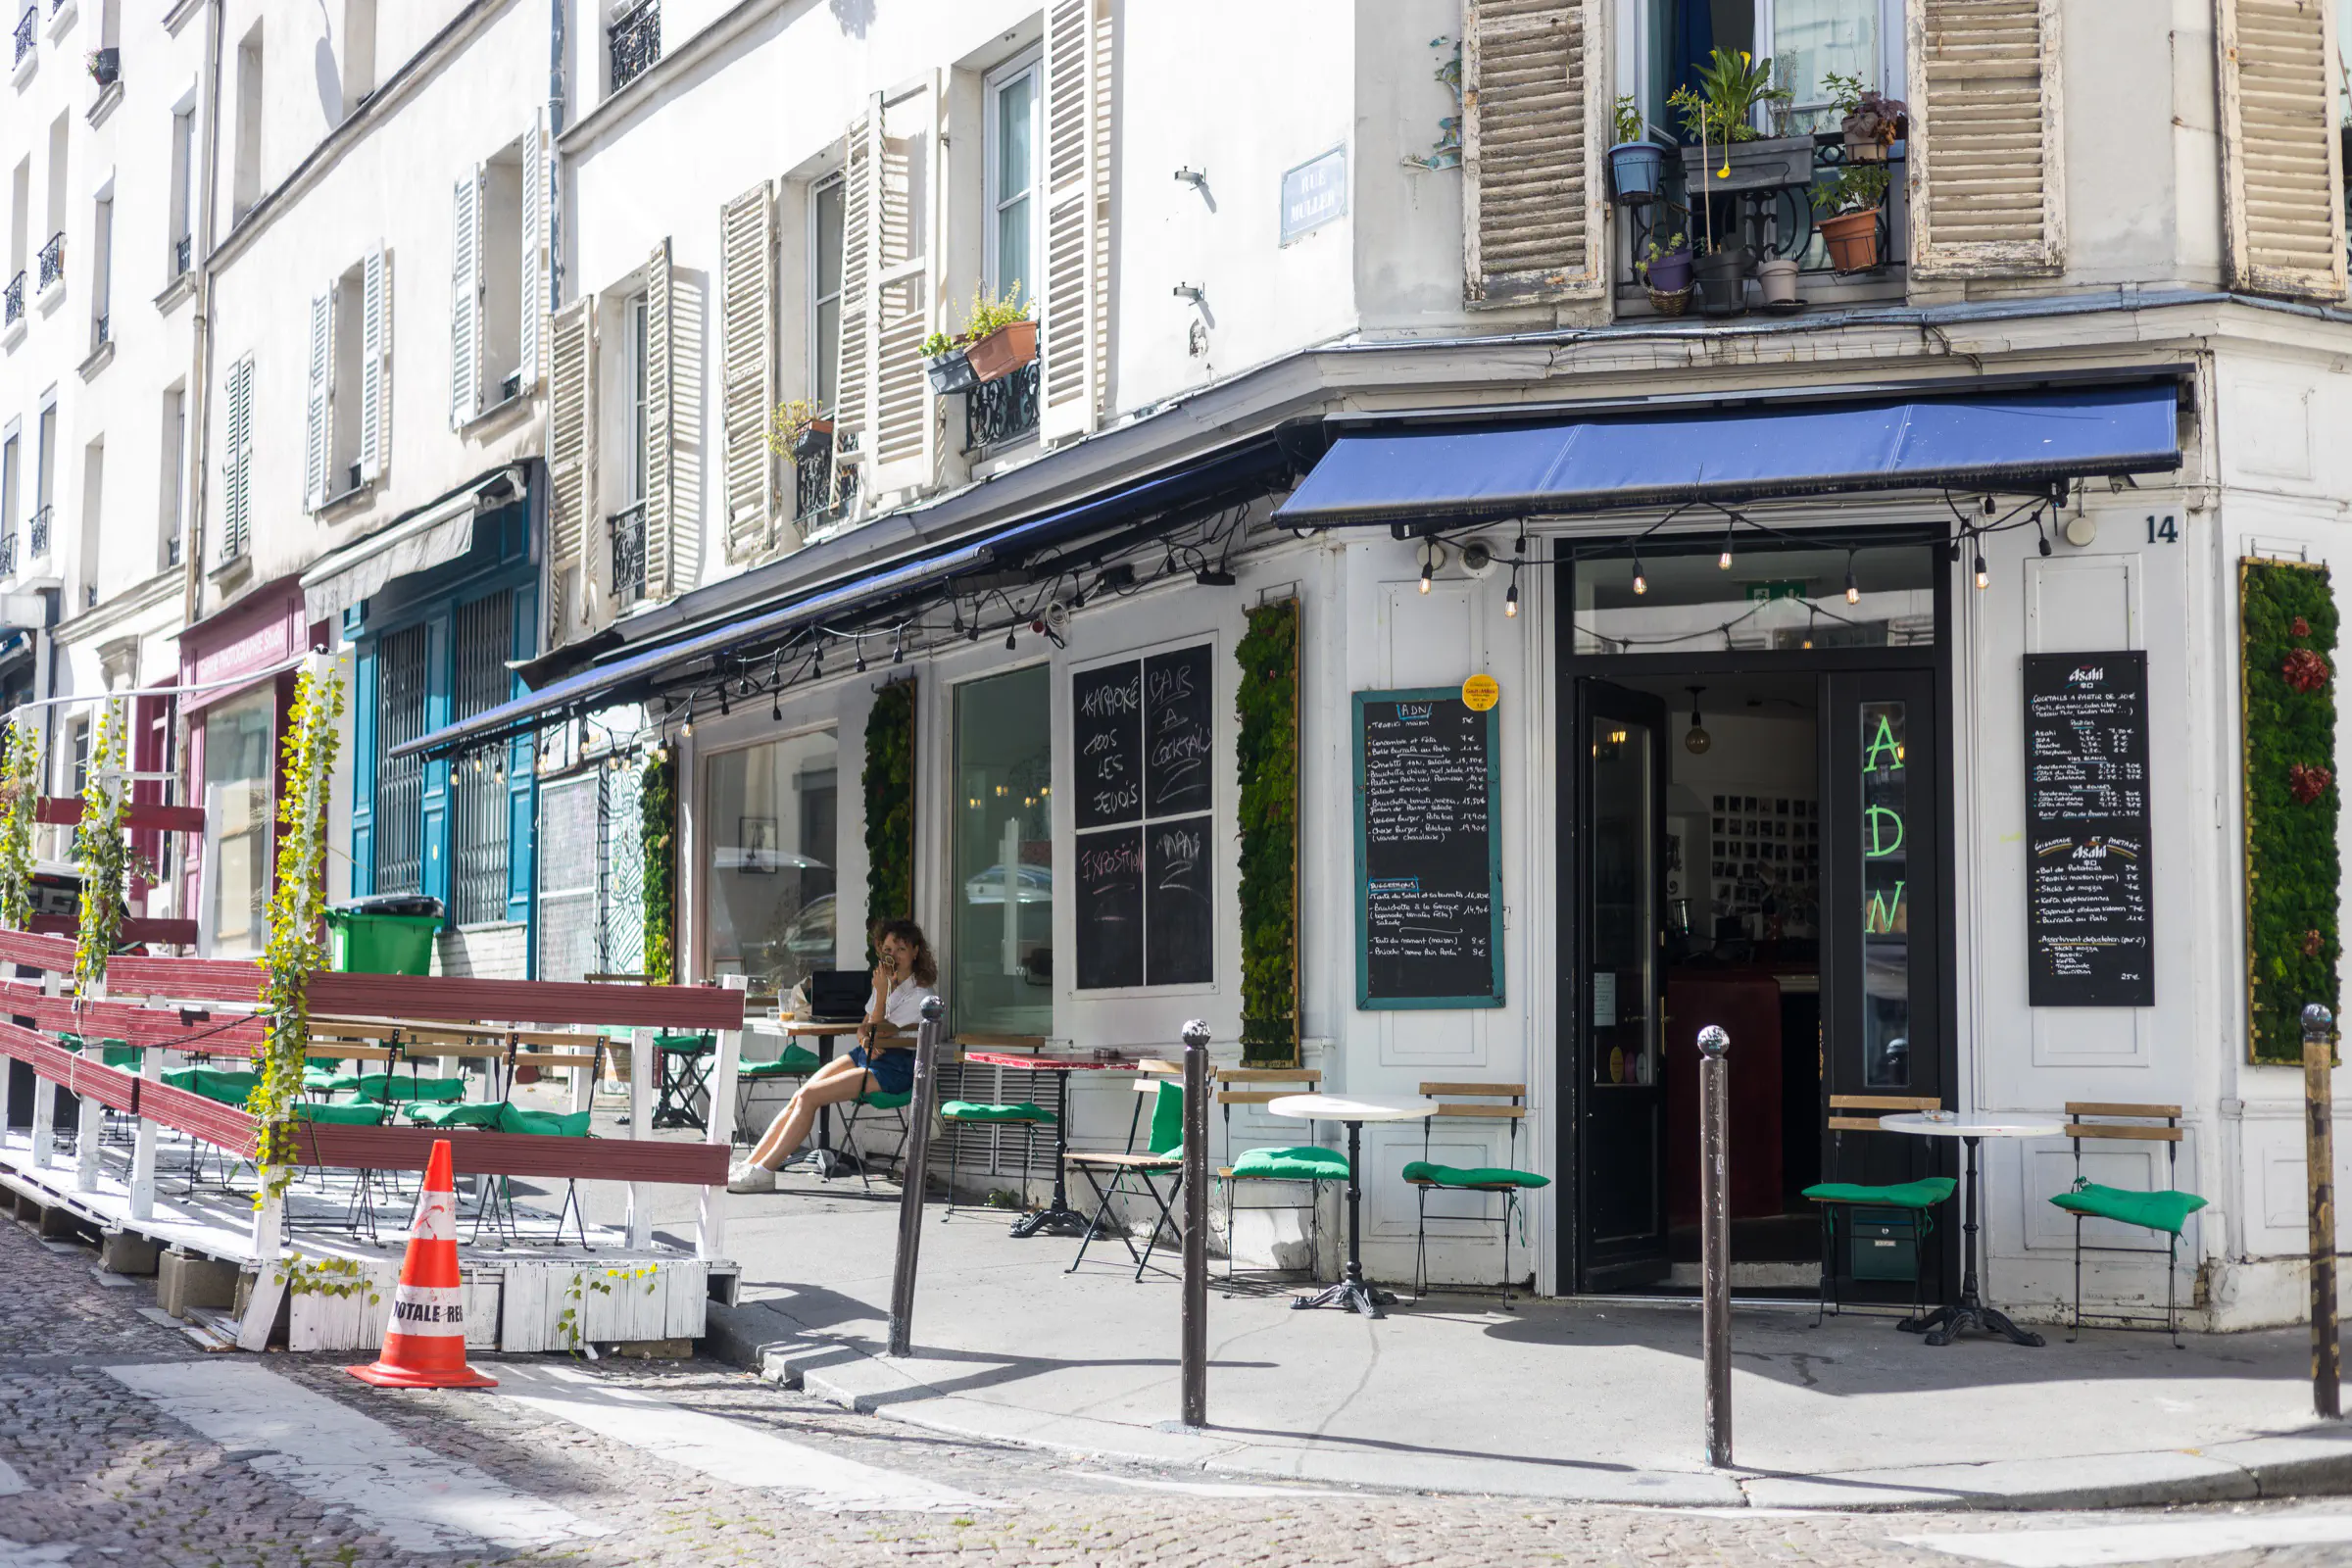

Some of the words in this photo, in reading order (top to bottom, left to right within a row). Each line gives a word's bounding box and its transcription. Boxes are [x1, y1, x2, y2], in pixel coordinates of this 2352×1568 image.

[1300, 169, 1326, 194] RUE
[1290, 189, 1335, 223] MULLER
[2146, 515, 2178, 543] 14
[1150, 665, 1194, 705] BAR
[2069, 667, 2104, 681] Asahi
[1401, 705, 1427, 716] ADN
[2033, 694, 2068, 704] COCKTAILS
[1162, 708, 1177, 728] A
[1099, 754, 1123, 779] LES
[1863, 714, 1905, 933] ADN
[2072, 845, 2107, 858] Asahi
[393, 1300, 441, 1323] TOTALE
